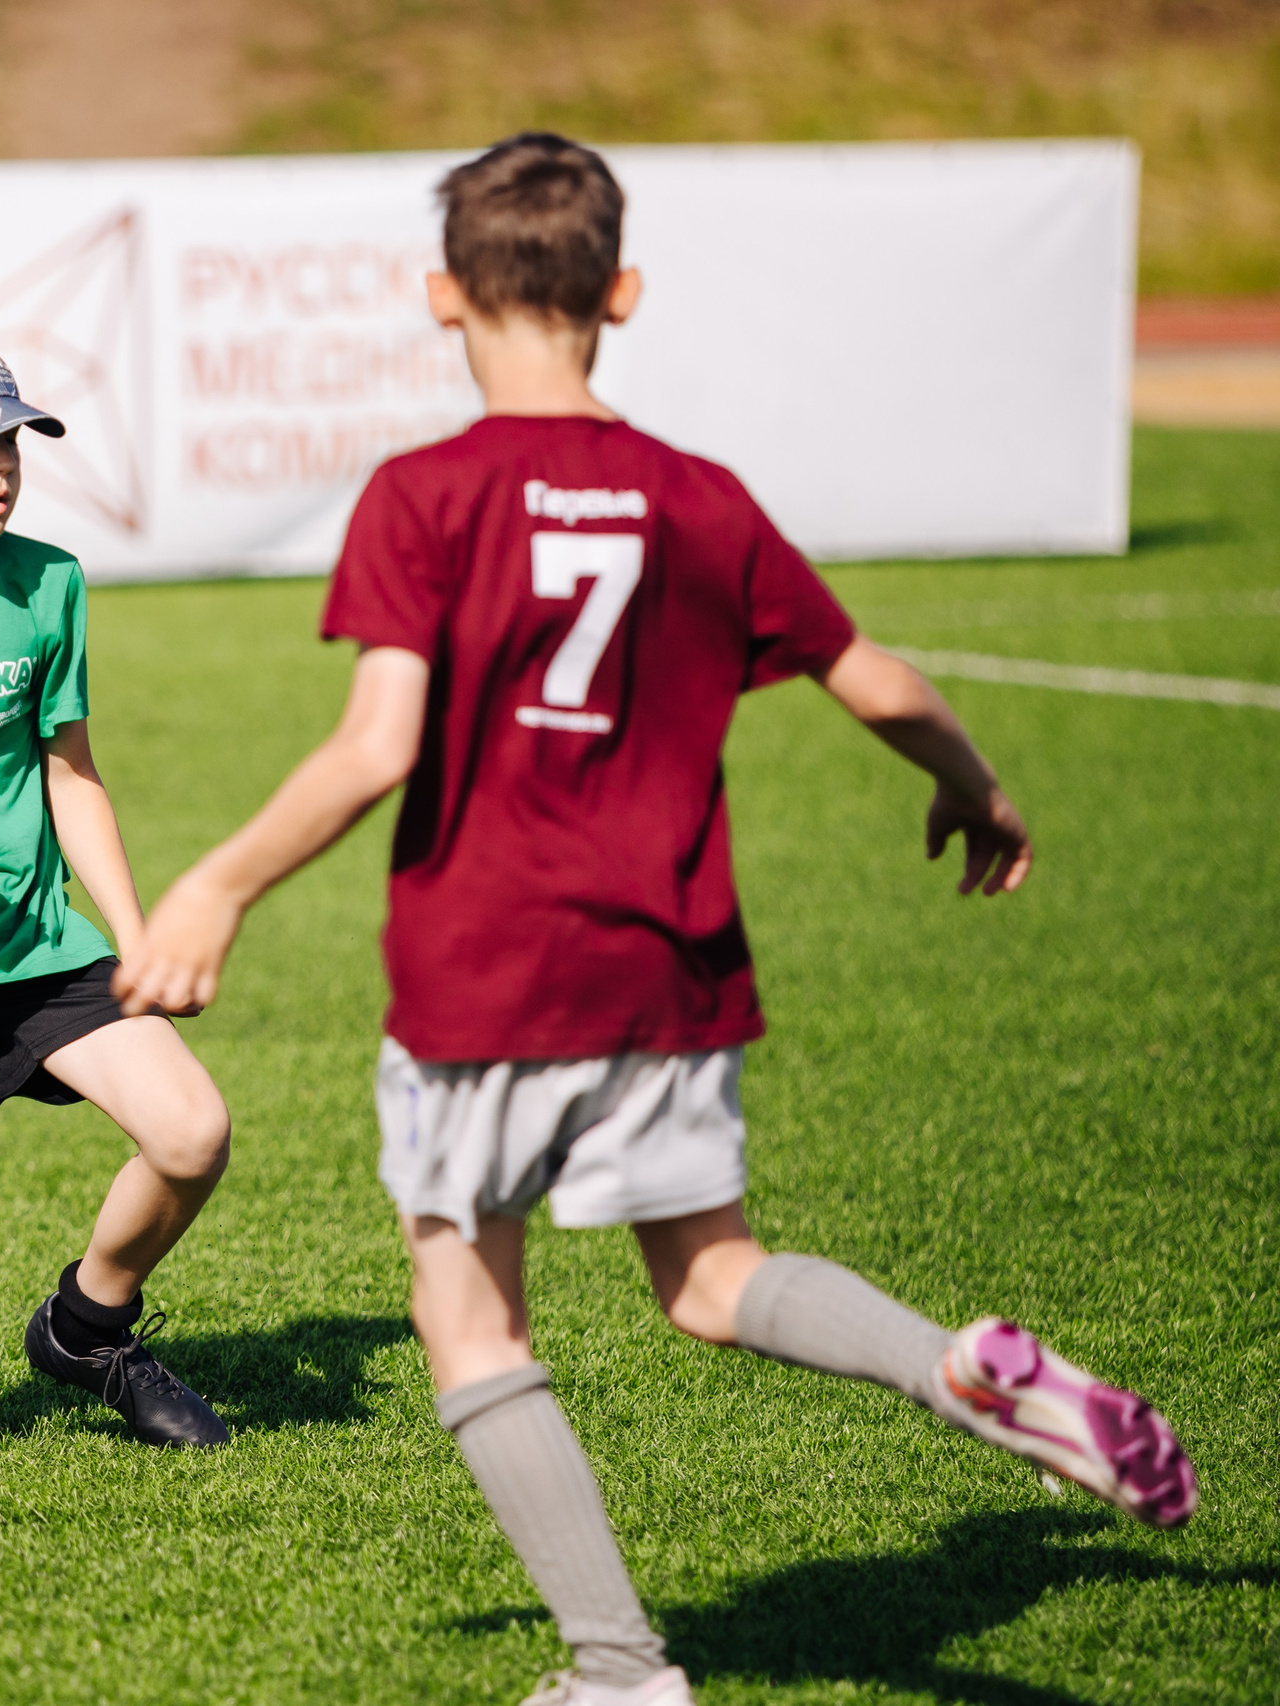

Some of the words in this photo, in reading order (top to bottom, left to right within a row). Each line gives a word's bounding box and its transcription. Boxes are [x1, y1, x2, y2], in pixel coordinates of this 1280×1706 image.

[181, 247, 432, 316] РУССК
[181, 332, 474, 403] МЕДНА
[530, 530, 645, 708] 7
